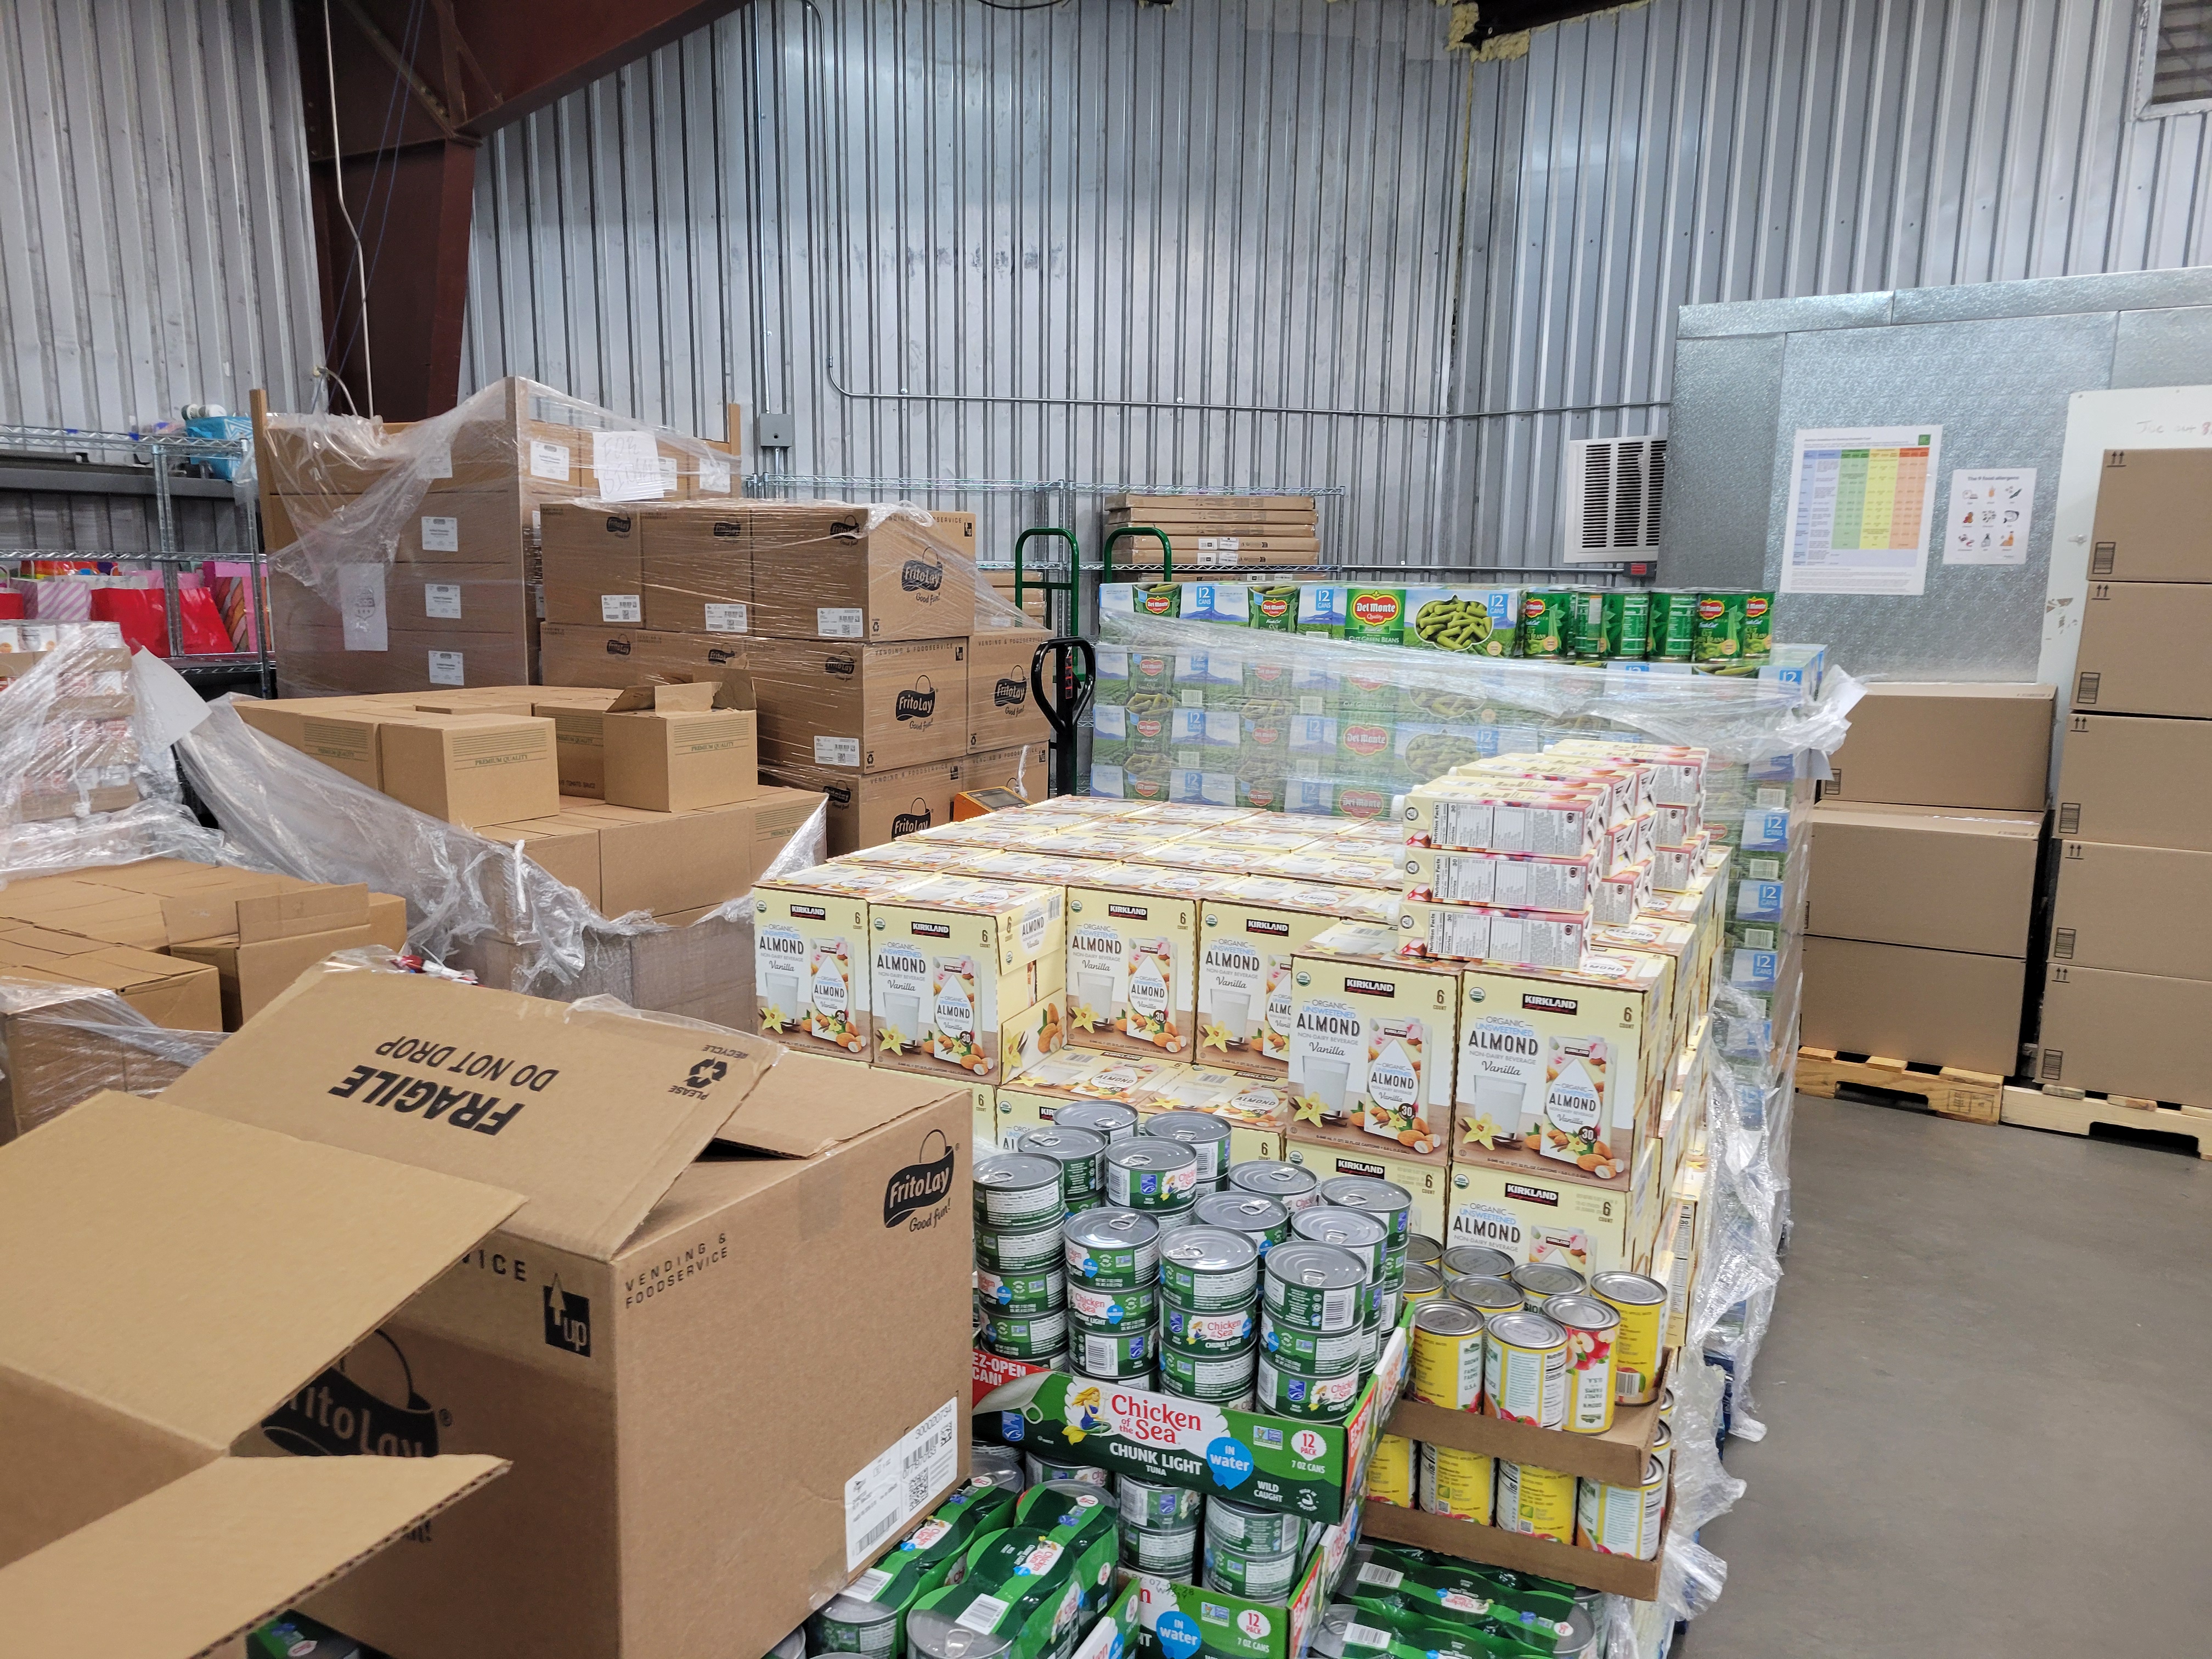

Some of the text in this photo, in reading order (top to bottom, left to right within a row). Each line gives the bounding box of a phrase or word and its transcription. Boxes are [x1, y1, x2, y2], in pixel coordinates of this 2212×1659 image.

[905, 567, 941, 587] FritoLay
[1199, 587, 1210, 598] 12
[1319, 590, 1330, 602] 12
[1357, 603, 1395, 612] Del Monte
[1491, 595, 1504, 607] 12
[913, 644, 953, 652] FOODSERVICE
[1783, 672, 1797, 682] 12
[997, 684, 1024, 700] FritoLay
[899, 695, 932, 713] FritoLay
[691, 744, 713, 752] PREMIUM
[475, 754, 528, 766] PREMIUM QUALITY
[870, 763, 948, 784] VENDING FOODSERVICE
[1768, 816, 1782, 828] 12
[1763, 887, 1777, 899] 12
[792, 905, 824, 915] KIRKLAND
[1110, 906, 1146, 915] KIRKLAND
[855, 912, 860, 923] 6
[1180, 912, 1186, 924] 6
[913, 923, 949, 933] KIRKLAND
[1022, 917, 1044, 936] ALMOND
[1248, 921, 1288, 931] KIRKLAND
[982, 930, 988, 942] 6
[1076, 929, 1118, 939] UNSWEETENED
[760, 936, 804, 955] ALMOND
[887, 942, 915, 950] ORGANIC
[1073, 936, 1121, 954] ALMOND
[1218, 939, 1248, 947] ORGANIC
[881, 948, 922, 958] UNSWEETENED
[1211, 945, 1256, 955] UNSWEETENED
[769, 961, 794, 972] Vanilla
[877, 955, 926, 974] ALMOND
[1082, 960, 1110, 971] Vanilla
[1206, 951, 1260, 971] ALMOND
[1757, 956, 1771, 968] 12
[888, 980, 915, 991] Vanilla
[1216, 977, 1247, 989] Vanilla
[1347, 979, 1393, 991] KIRKLAND
[814, 985, 844, 998] ALMOND
[1131, 985, 1164, 998] ALMOND
[1437, 990, 1444, 1004] 6
[1312, 1000, 1347, 1009] ORGANIC
[1525, 996, 1576, 1009] KIRKLAND
[937, 1005, 969, 1019] ALMOND
[1155, 1012, 1164, 1020] 30
[1302, 1006, 1356, 1018] UNSWEETENED
[1623, 1007, 1633, 1022] 6
[1297, 1013, 1360, 1037] ALMOND
[1486, 1016, 1525, 1028] ORGANIC
[1475, 1023, 1533, 1036] UNSWEETENED
[962, 1033, 969, 1042] 30
[1297, 1032, 1358, 1045] NON-DAIRY BEVERAGE
[1469, 1031, 1538, 1056] ALMOND
[702, 1045, 749, 1059] RECYCLE
[1309, 1042, 1345, 1056] Vanilla
[375, 1036, 559, 1092] DO NOT DROP
[1469, 1051, 1536, 1065] NON-DAIRY BEVERAGE
[1482, 1061, 1521, 1076] Vanilla
[1096, 1074, 1135, 1084] ALMOND
[1371, 1072, 1414, 1089] ALMOND
[668, 1085, 709, 1100] PLEASE
[1379, 1092, 1403, 1102] Vanilla
[328, 1064, 526, 1136] FRAGILE
[978, 1093, 984, 1106] 6
[1237, 1096, 1276, 1107] ALMOND
[1549, 1093, 1595, 1111] ALMOND
[1402, 1107, 1412, 1116] 30
[1557, 1114, 1583, 1125] Vanilla
[1582, 1129, 1593, 1139] 30
[1261, 1142, 1267, 1154] 6
[1338, 1160, 1384, 1174] KIRKLAND
[889, 1167, 949, 1209] FritoLay
[1426, 1175, 1433, 1188] 6
[1508, 1185, 1557, 1200] KIRKLAND
[909, 1197, 951, 1232] Good fun!
[1470, 1203, 1506, 1215] ORGANIC
[1603, 1201, 1611, 1216] 6
[1460, 1209, 1516, 1224] UNSWEETENED
[1453, 1216, 1520, 1243] ALMOND
[1454, 1235, 1519, 1252] NON-DAIRY BEVERAGE
[625, 1233, 726, 1292] VENDING &
[625, 1246, 728, 1308] FOODSERVICE
[1075, 1294, 1105, 1308] Chicken
[1082, 1304, 1095, 1313] Sea
[1207, 1319, 1241, 1331] Chicken
[563, 1317, 586, 1351] up
[1217, 1329, 1233, 1337] Sea
[973, 1352, 1026, 1377] EZ-OPEN
[973, 1367, 1002, 1386] CAN!
[1111, 1393, 1202, 1431] Chicken
[915, 1404, 952, 1439] 300020734
[1121, 1418, 1131, 1427] of
[1119, 1424, 1133, 1435] the
[1135, 1420, 1176, 1444] Sea
[1302, 1434, 1314, 1448] 12
[1225, 1446, 1235, 1455] IN
[1300, 1447, 1317, 1455] PACK
[1109, 1442, 1202, 1475] CHUNK LIGHT
[1210, 1454, 1250, 1471] water
[1146, 1465, 1167, 1476] TUNA
[1297, 1462, 1306, 1470] OZ
[1307, 1464, 1325, 1474] CANS
[1257, 1481, 1279, 1493] WILD
[1254, 1489, 1283, 1503] CAUGHT
[1032, 1551, 1053, 1571] Chicken
[1174, 1619, 1183, 1628] IN
[1248, 1613, 1259, 1627] 12
[1160, 1627, 1198, 1645] water
[1243, 1640, 1251, 1648] OZ
[1252, 1641, 1269, 1652] CANS
